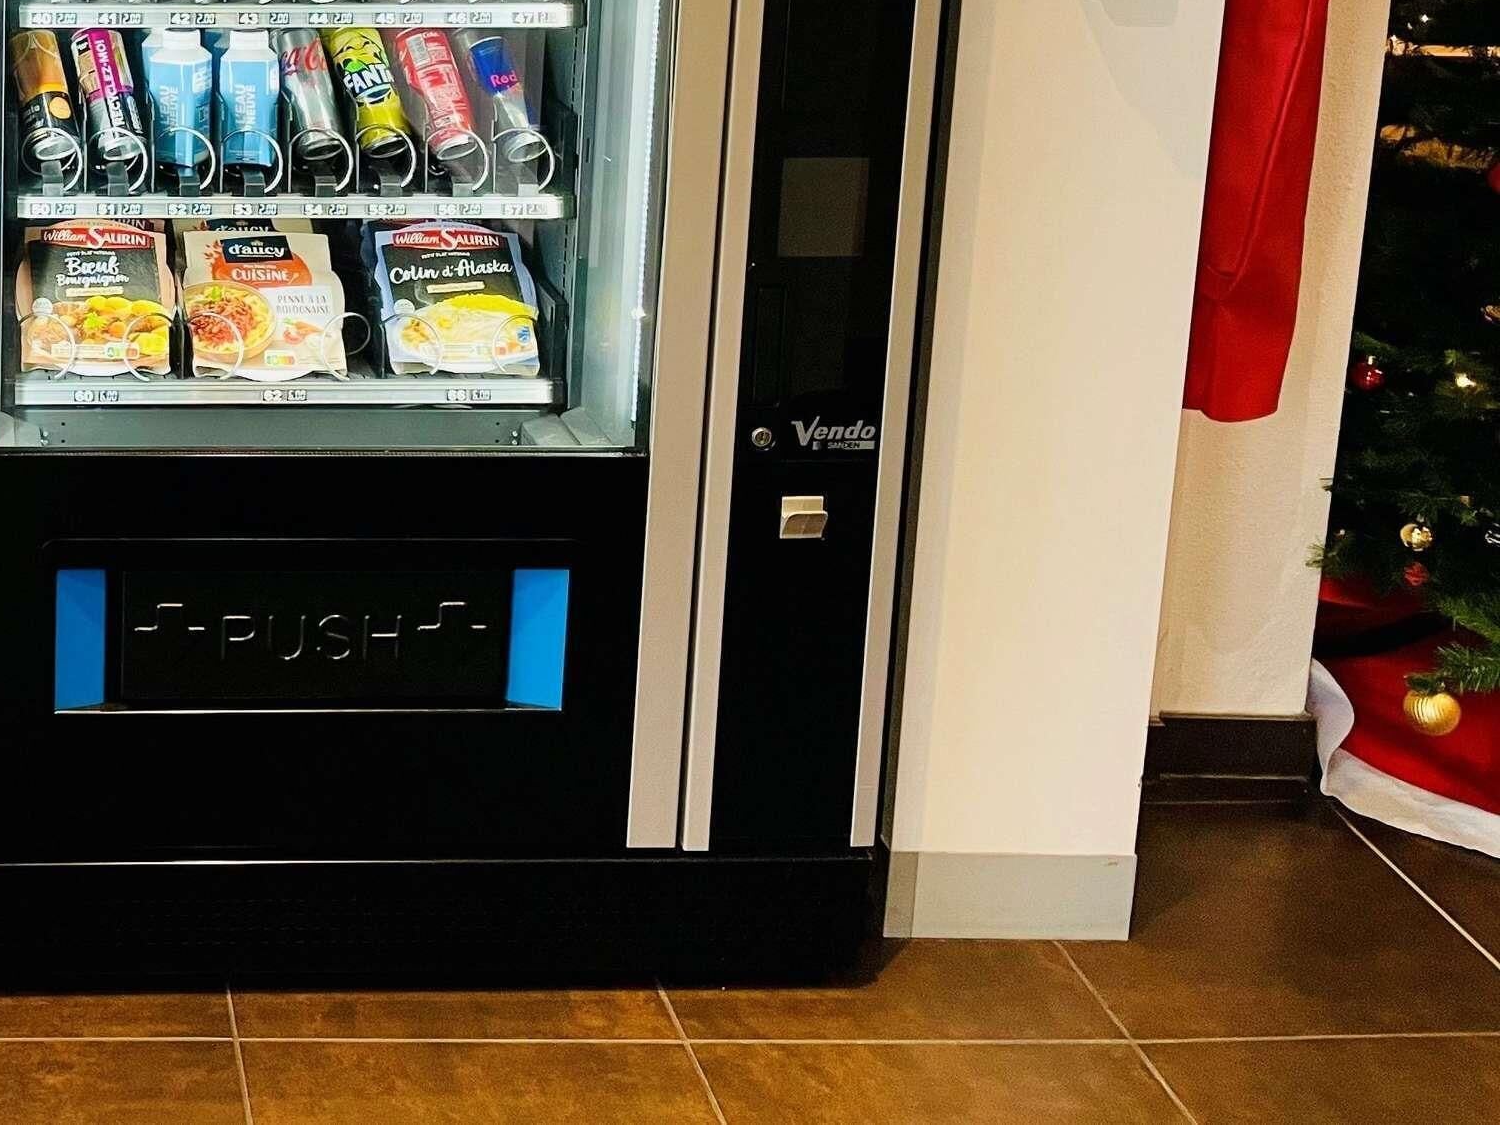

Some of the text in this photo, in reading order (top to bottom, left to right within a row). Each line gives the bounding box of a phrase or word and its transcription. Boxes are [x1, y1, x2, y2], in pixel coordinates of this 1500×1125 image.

[98, 13, 117, 24] 41
[171, 13, 190, 24] 42
[239, 13, 259, 24] 43
[309, 13, 329, 24] 44
[375, 13, 395, 24] 45
[490, 72, 517, 88] Red
[167, 203, 187, 215] 52
[232, 203, 253, 215] 53
[303, 203, 323, 215] 54
[43, 225, 147, 250] William SAURIN
[396, 227, 500, 251] William SAURIN
[228, 243, 285, 258] d'aucy
[389, 258, 513, 284] Colin d'Alaska
[55, 274, 130, 288] Bourguignon
[276, 305, 331, 314] BOLOGNAISE
[74, 390, 94, 402] 60
[263, 390, 283, 402] 62
[790, 415, 876, 447] Vendo
[222, 613, 401, 661] PUSH
